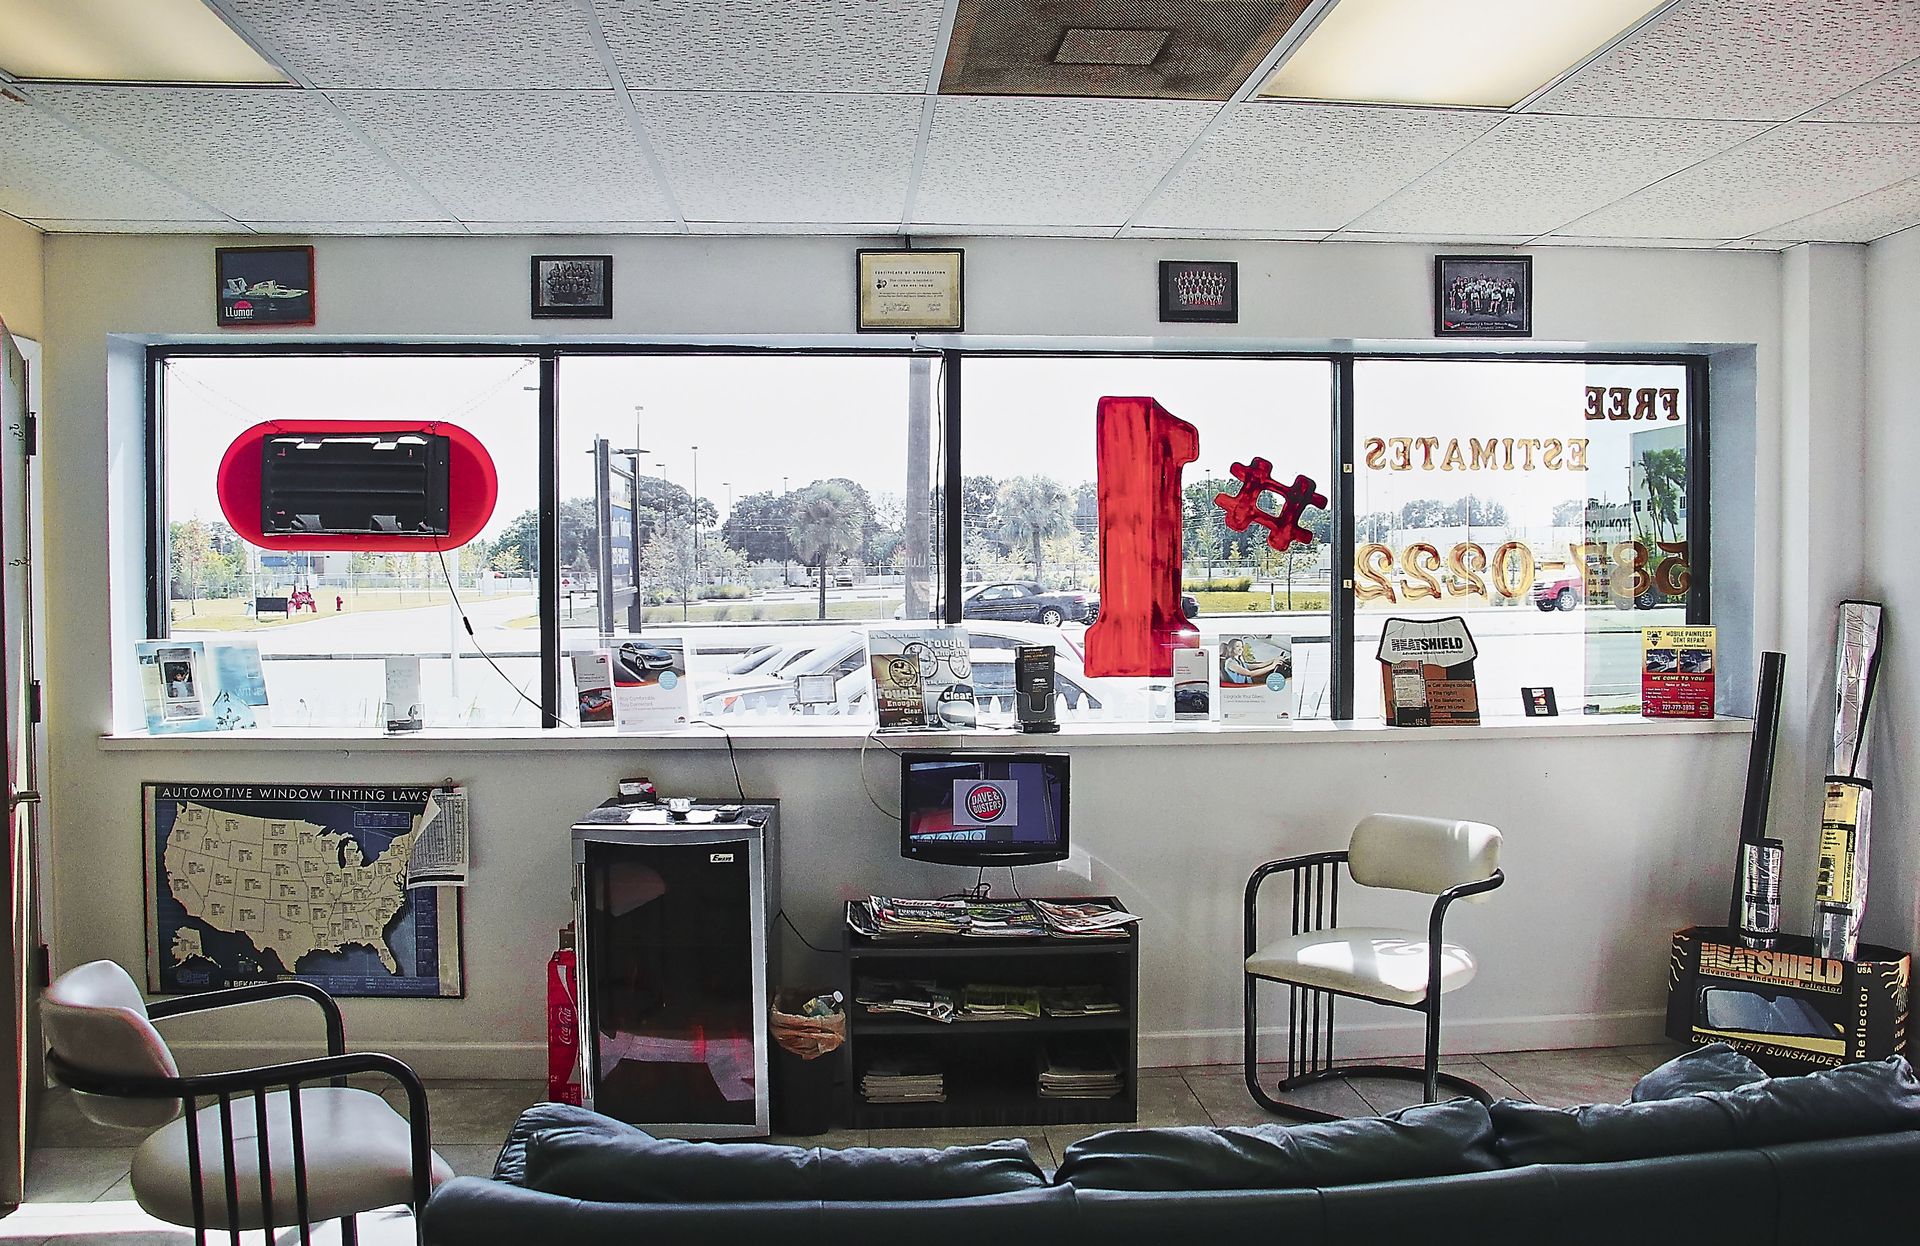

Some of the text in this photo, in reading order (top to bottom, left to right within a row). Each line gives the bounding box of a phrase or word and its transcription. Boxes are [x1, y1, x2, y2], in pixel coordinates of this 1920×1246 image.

[925, 638, 964, 649] Tough
[1392, 638, 1463, 651] HEATSHIELD
[878, 687, 917, 700] Tough
[944, 692, 973, 700] Clear.
[887, 700, 919, 708] Enough?
[162, 788, 428, 800] AUTOMOTIVE WINDOW TINTING LAWS
[971, 790, 1000, 805] DAVE &
[1700, 942, 1843, 985] HEATSHIELD
[1700, 967, 1841, 993] advanced windshield reflector
[1856, 987, 1868, 1058] Reflector
[1766, 1047, 1843, 1066] SUNSHADES
